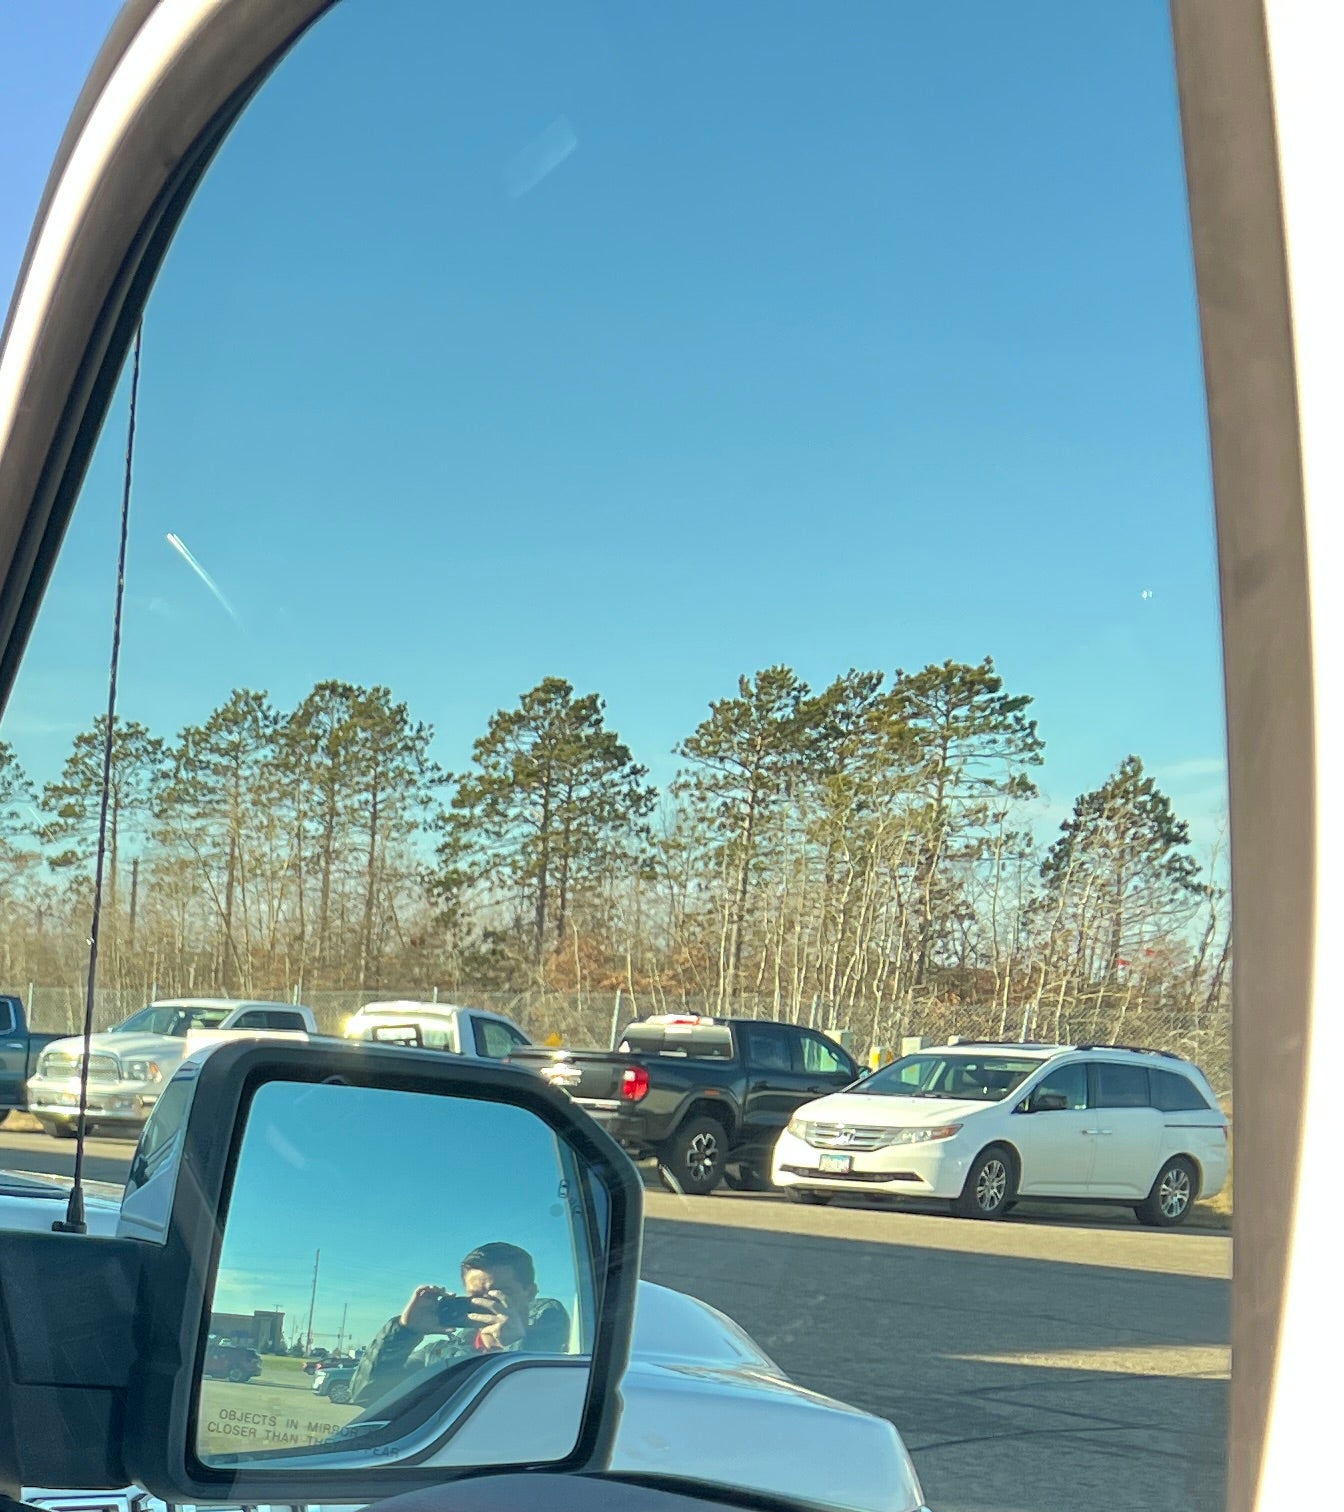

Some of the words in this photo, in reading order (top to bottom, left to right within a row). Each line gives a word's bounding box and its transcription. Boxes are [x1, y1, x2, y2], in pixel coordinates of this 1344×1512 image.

[219, 1408, 277, 1427] OBJECTS
[286, 1418, 299, 1430] IN
[207, 1421, 257, 1438] CLOSER
[265, 1429, 299, 1444] THAN
